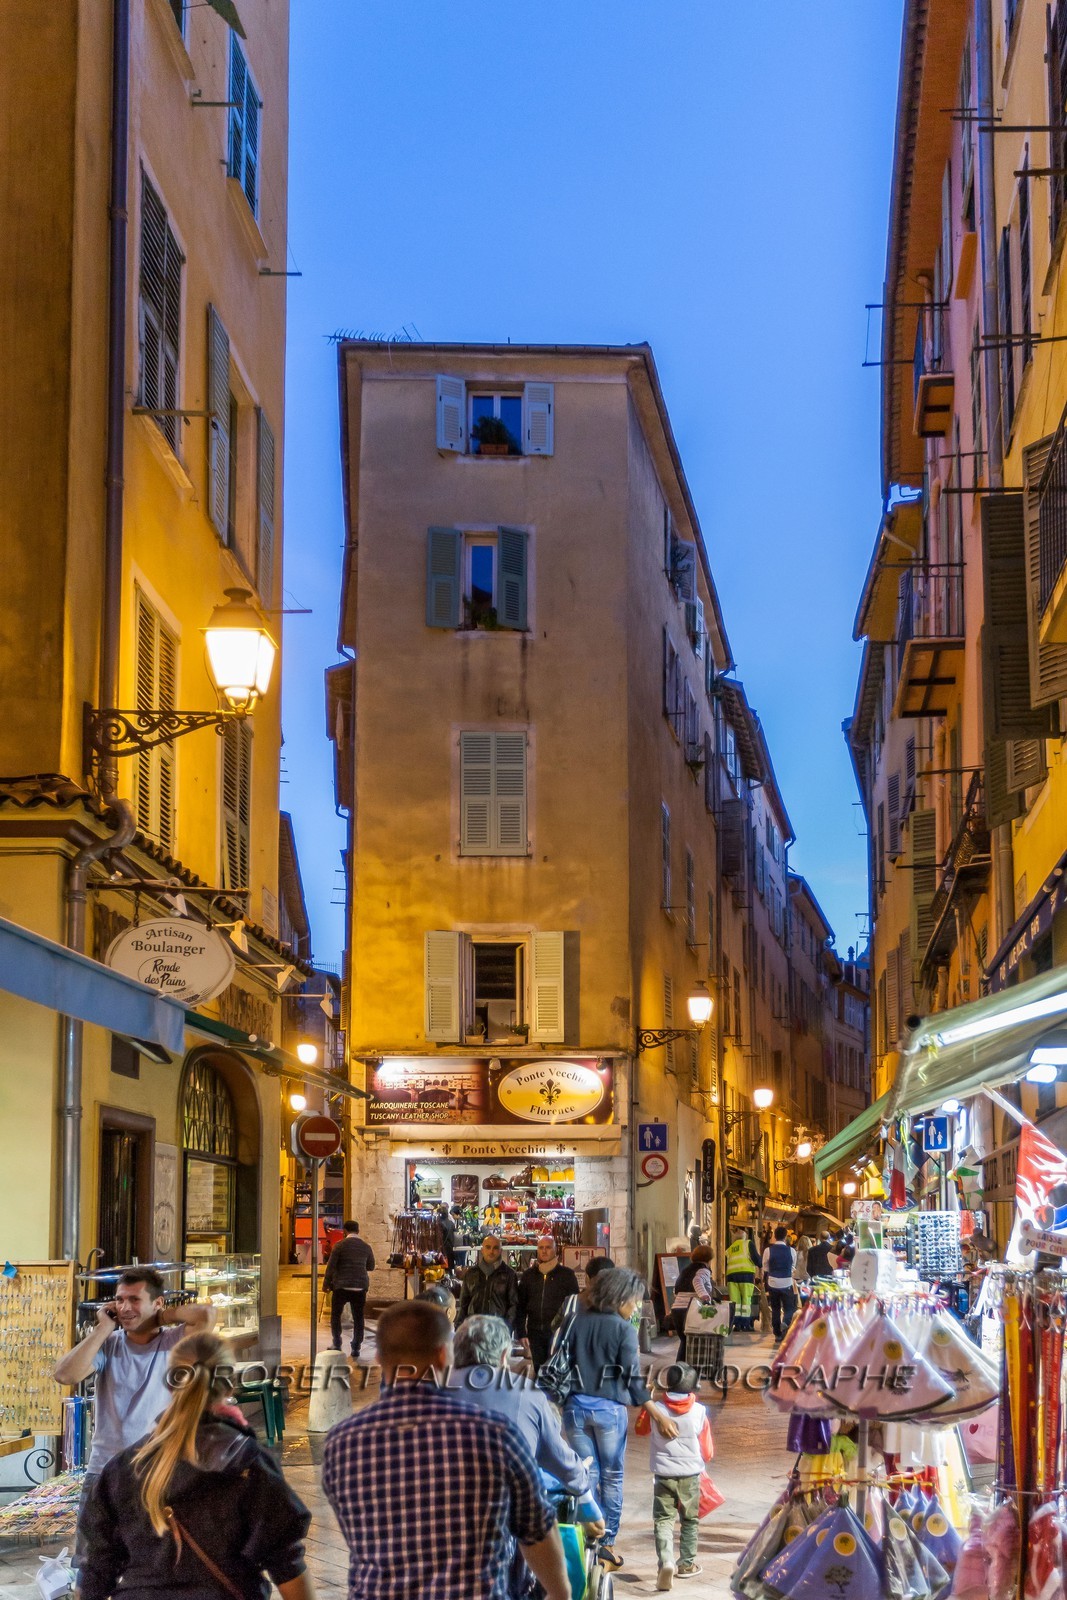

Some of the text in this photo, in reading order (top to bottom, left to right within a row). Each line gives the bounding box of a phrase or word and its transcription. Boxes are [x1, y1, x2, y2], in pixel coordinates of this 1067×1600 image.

[145, 927, 193, 942] Artisan
[131, 940, 206, 957] Boulanger
[152, 958, 181, 975] Ronde
[144, 973, 186, 988] des Pains
[516, 1067, 587, 1086] Ponte Vecchio
[369, 1102, 418, 1110] MAROQUINERIE
[529, 1104, 575, 1116] Florence
[401, 1112, 430, 1120] LEATHER
[463, 1144, 546, 1154] Ponte Vecchio
